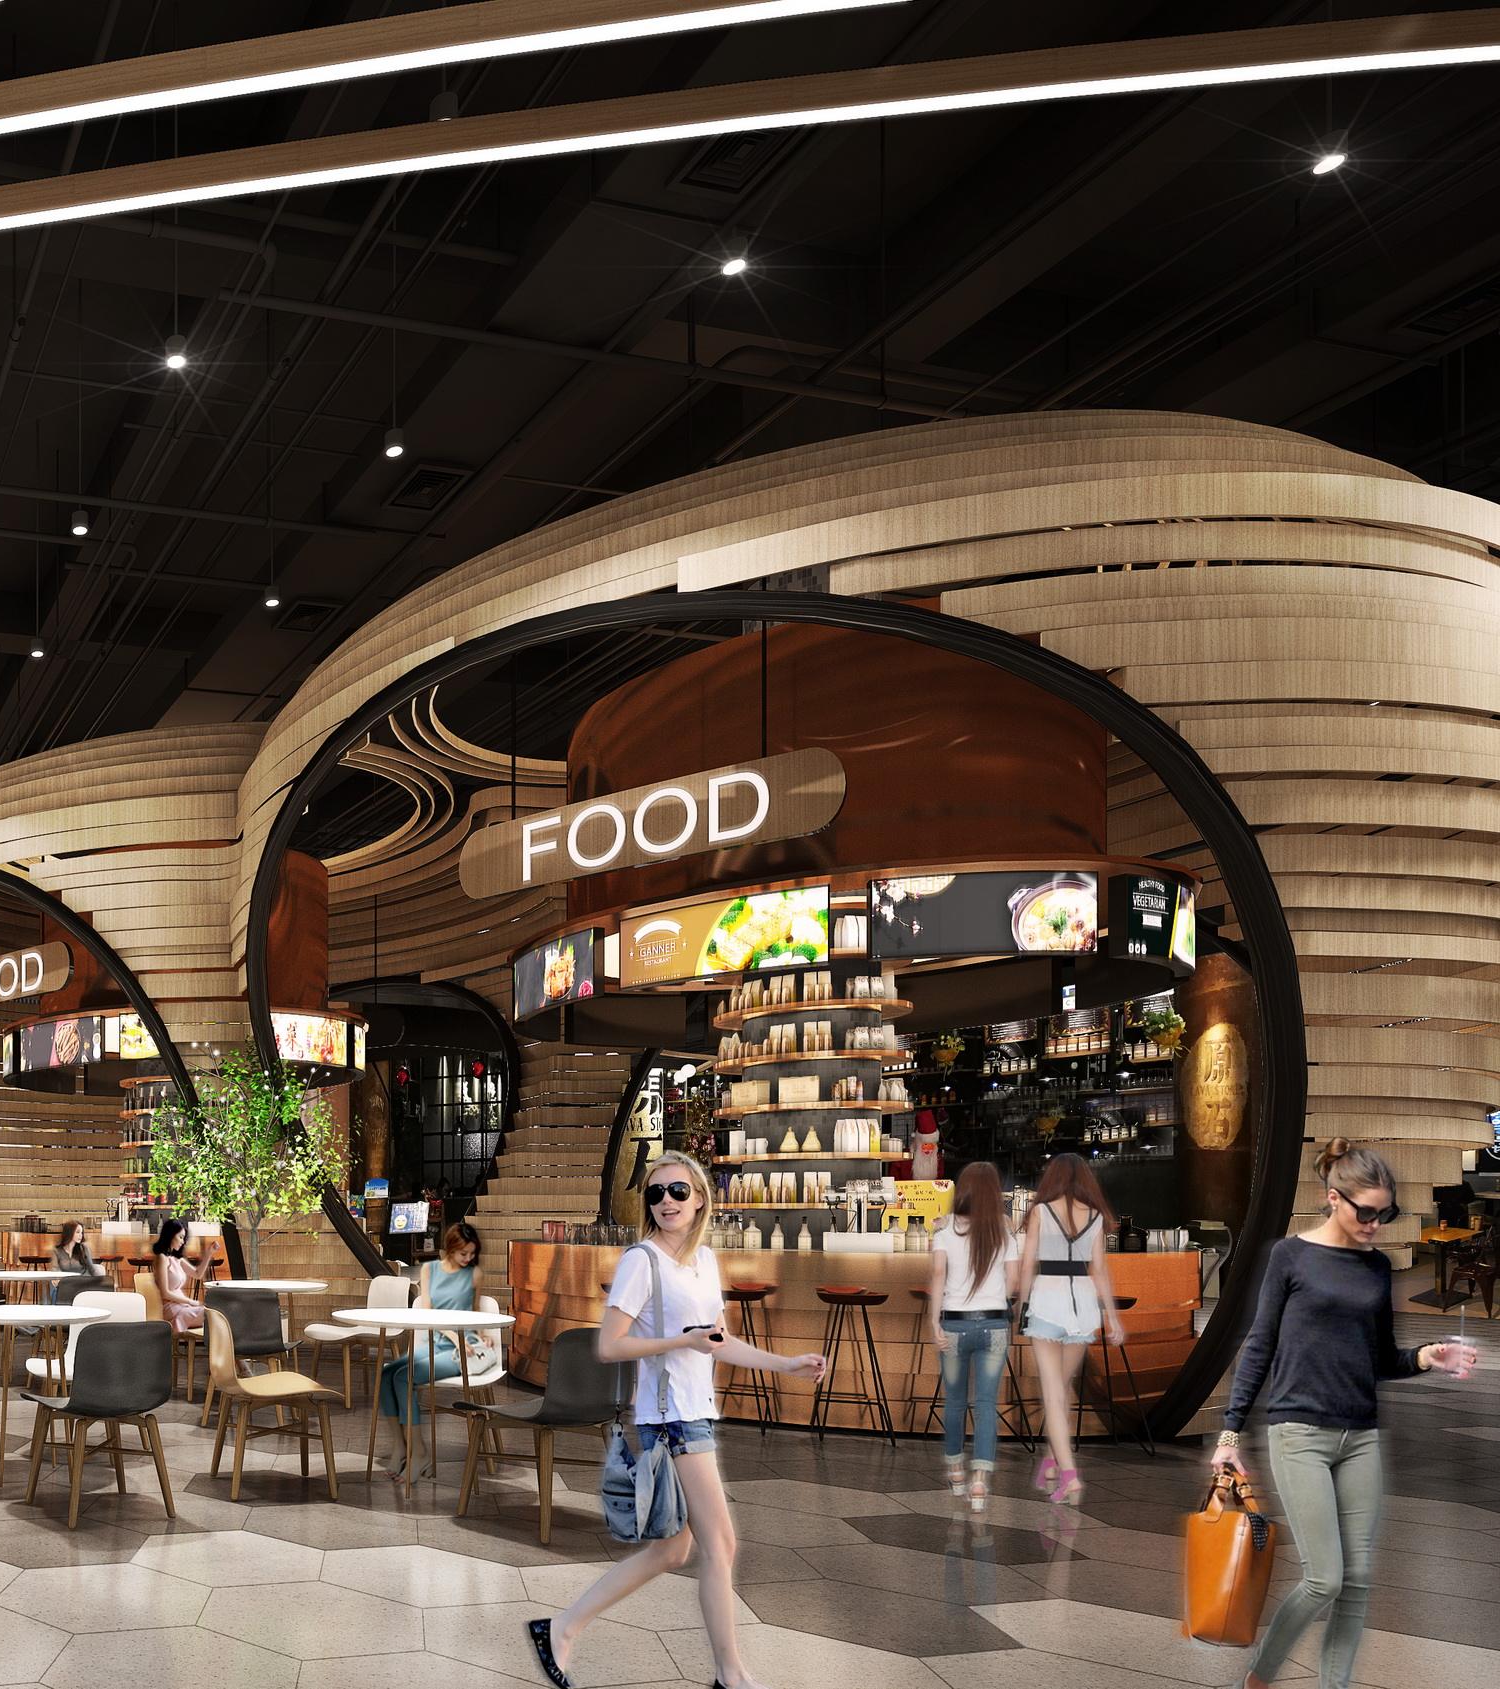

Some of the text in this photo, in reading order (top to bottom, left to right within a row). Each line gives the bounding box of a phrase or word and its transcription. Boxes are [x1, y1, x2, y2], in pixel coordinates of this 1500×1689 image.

[521, 771, 770, 883] FOOD
[1132, 895, 1166, 911] VEGETARIAN
[626, 1117, 644, 1132] VA
